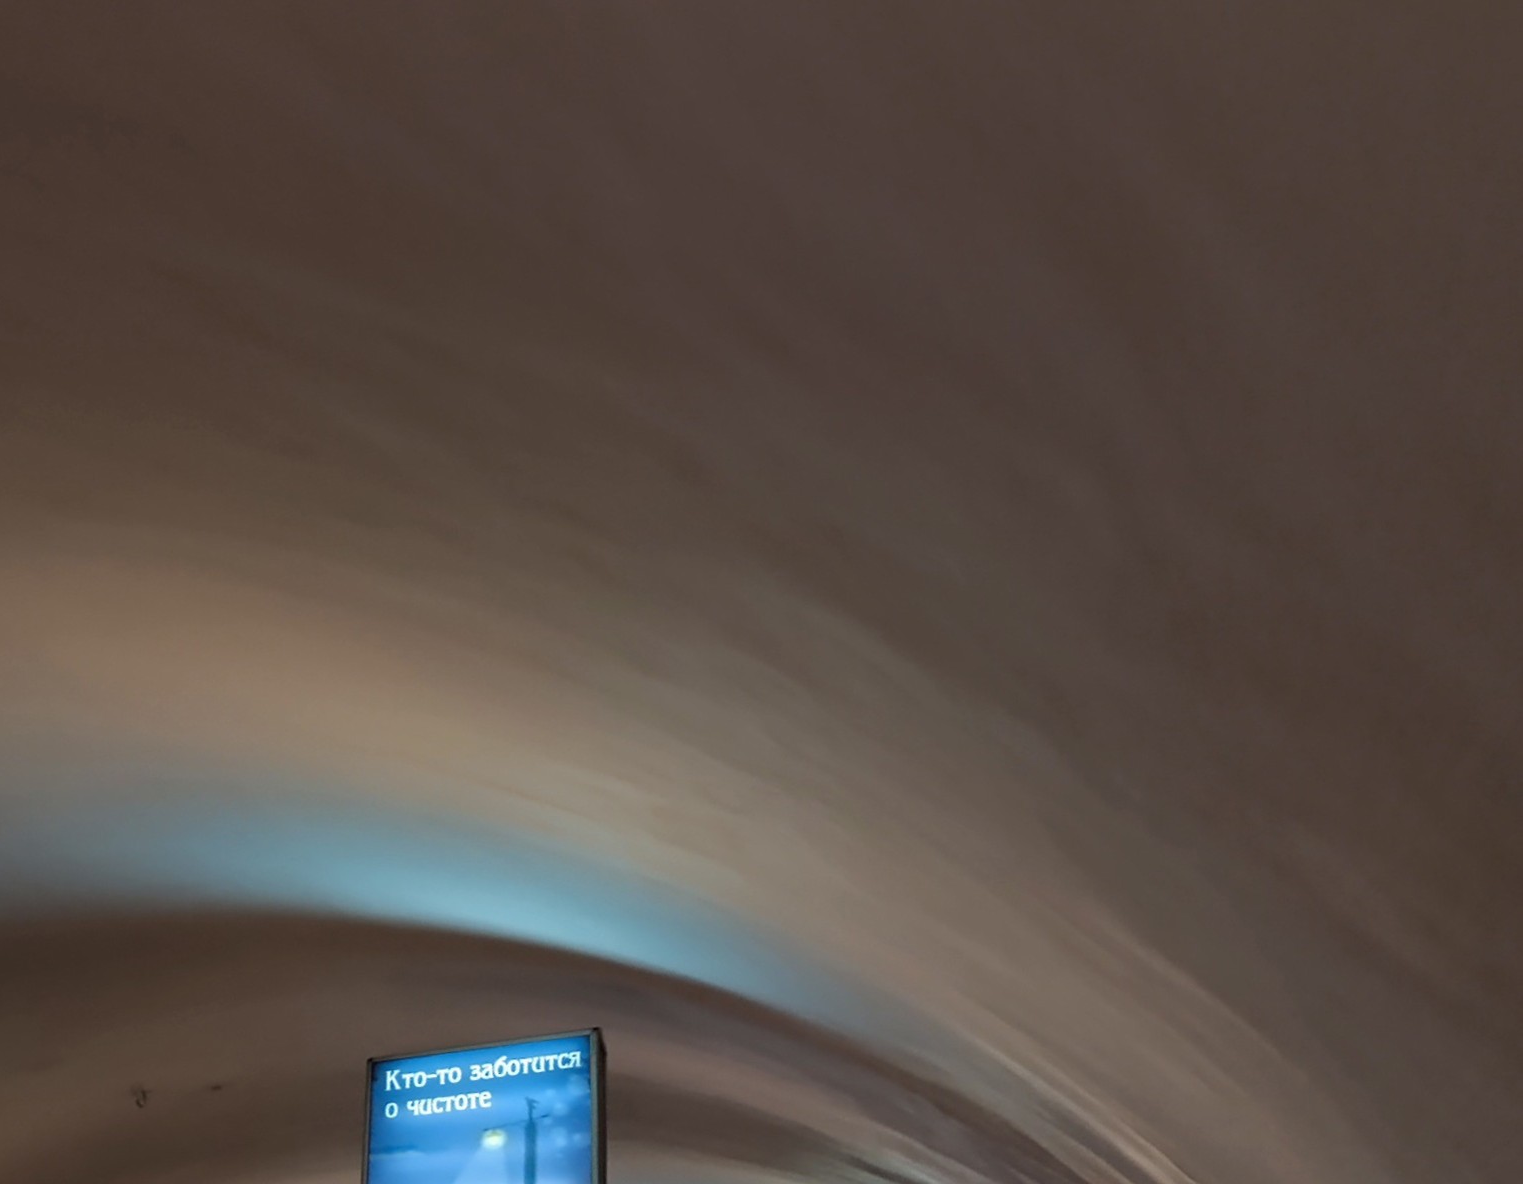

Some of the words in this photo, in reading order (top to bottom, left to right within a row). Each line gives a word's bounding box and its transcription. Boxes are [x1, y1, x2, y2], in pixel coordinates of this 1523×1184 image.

[385, 1066, 462, 1091] Кто-то
[469, 1051, 581, 1081] заботится
[385, 1102, 399, 1119] о
[406, 1090, 493, 1116] чистоте
